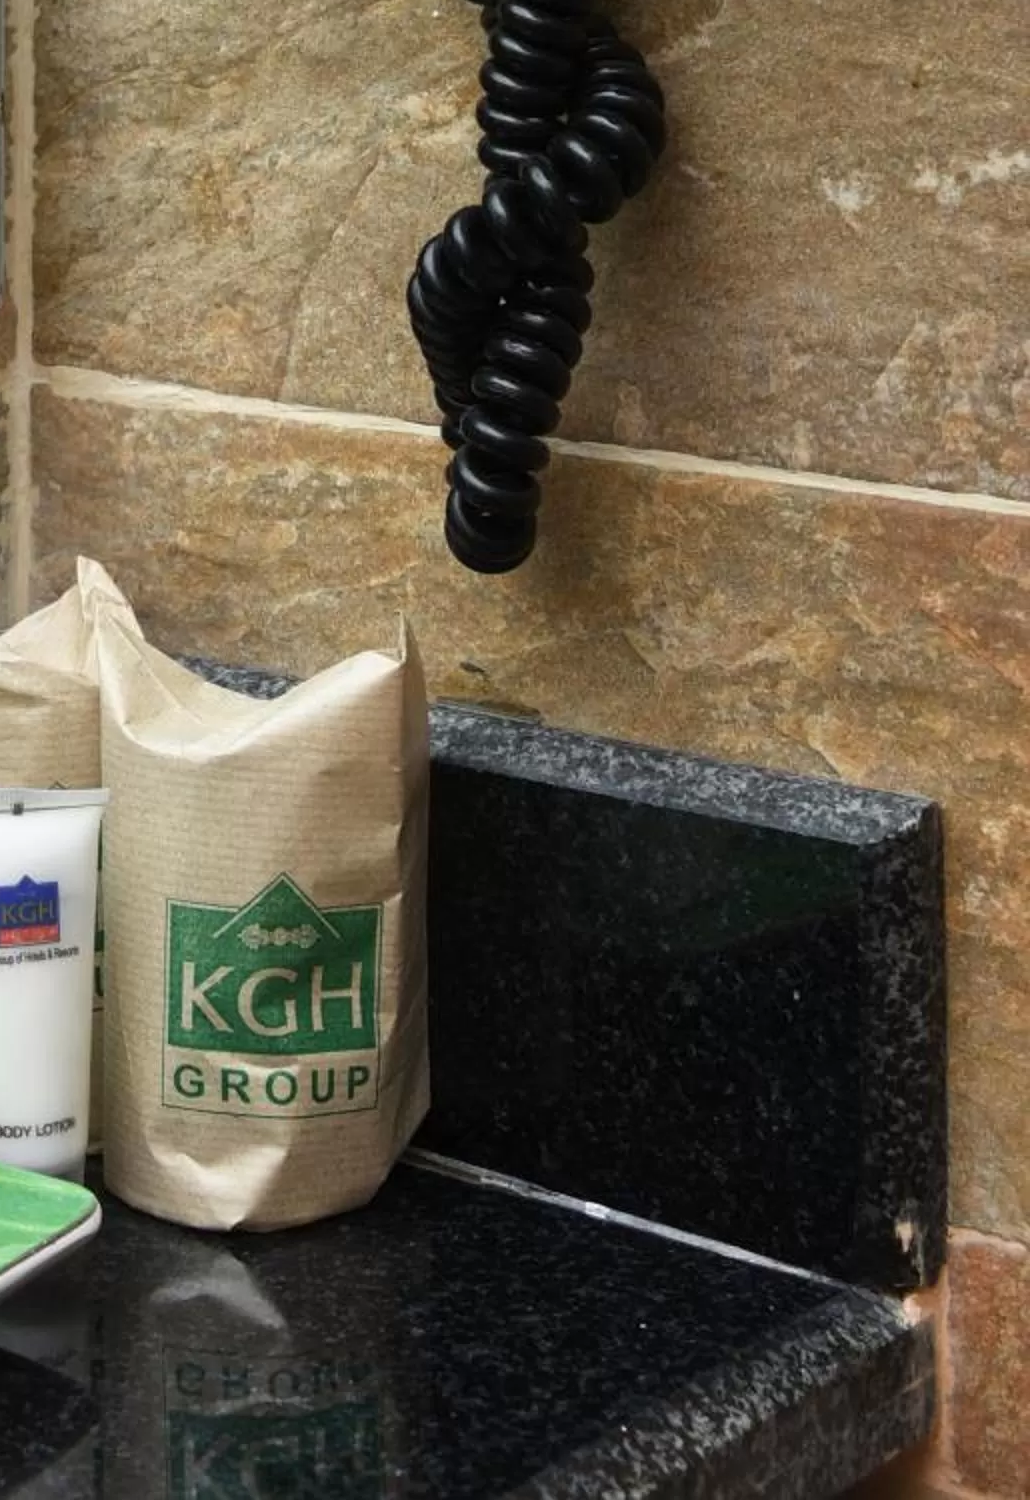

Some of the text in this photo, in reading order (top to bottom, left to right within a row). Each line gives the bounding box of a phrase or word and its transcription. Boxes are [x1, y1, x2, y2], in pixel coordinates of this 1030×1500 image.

[1, 900, 55, 924] KGH
[179, 961, 363, 1037] KGH
[173, 1064, 370, 1106] GROUP
